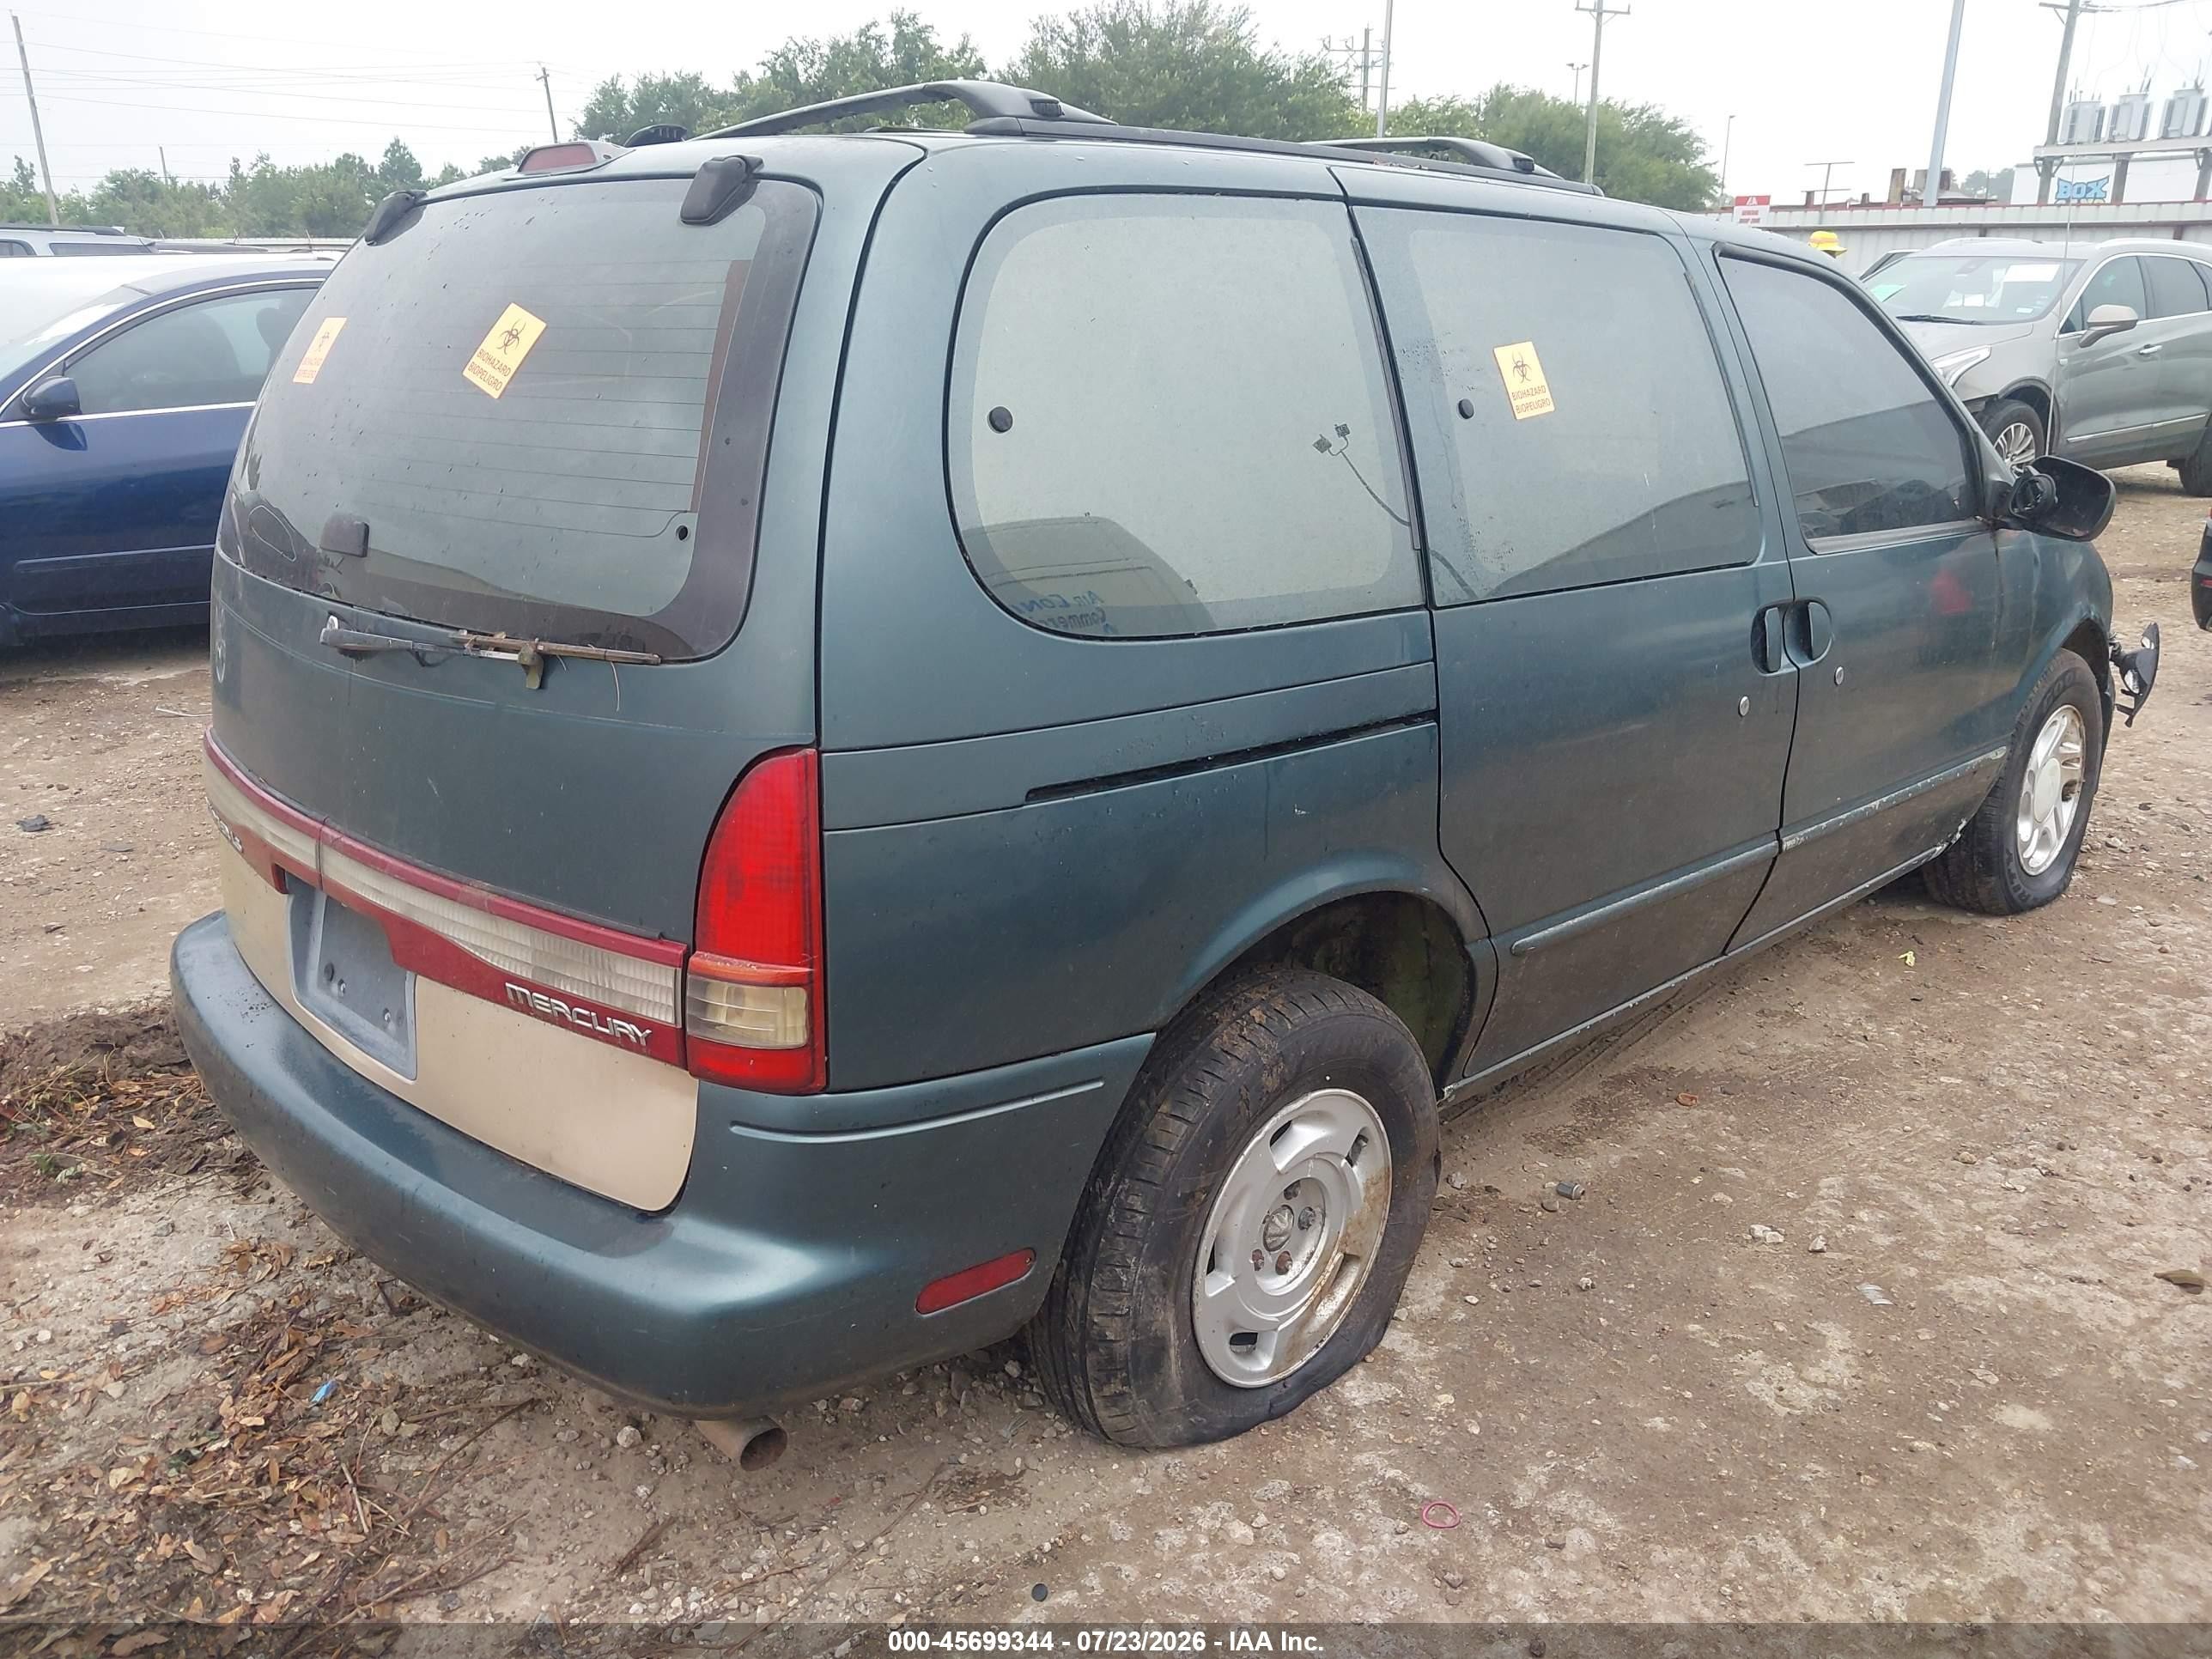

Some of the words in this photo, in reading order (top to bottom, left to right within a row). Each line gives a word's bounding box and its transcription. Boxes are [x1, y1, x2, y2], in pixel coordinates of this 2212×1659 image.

[2055, 175, 2111, 199] BOX
[477, 349, 512, 377] BIOHAZARD
[467, 362, 503, 391] BIOPELIGRO
[1511, 385, 1547, 401] BIOHAZARD
[1516, 398, 1551, 414] BIOPELIGRO
[505, 981, 652, 1046] MERCURY
